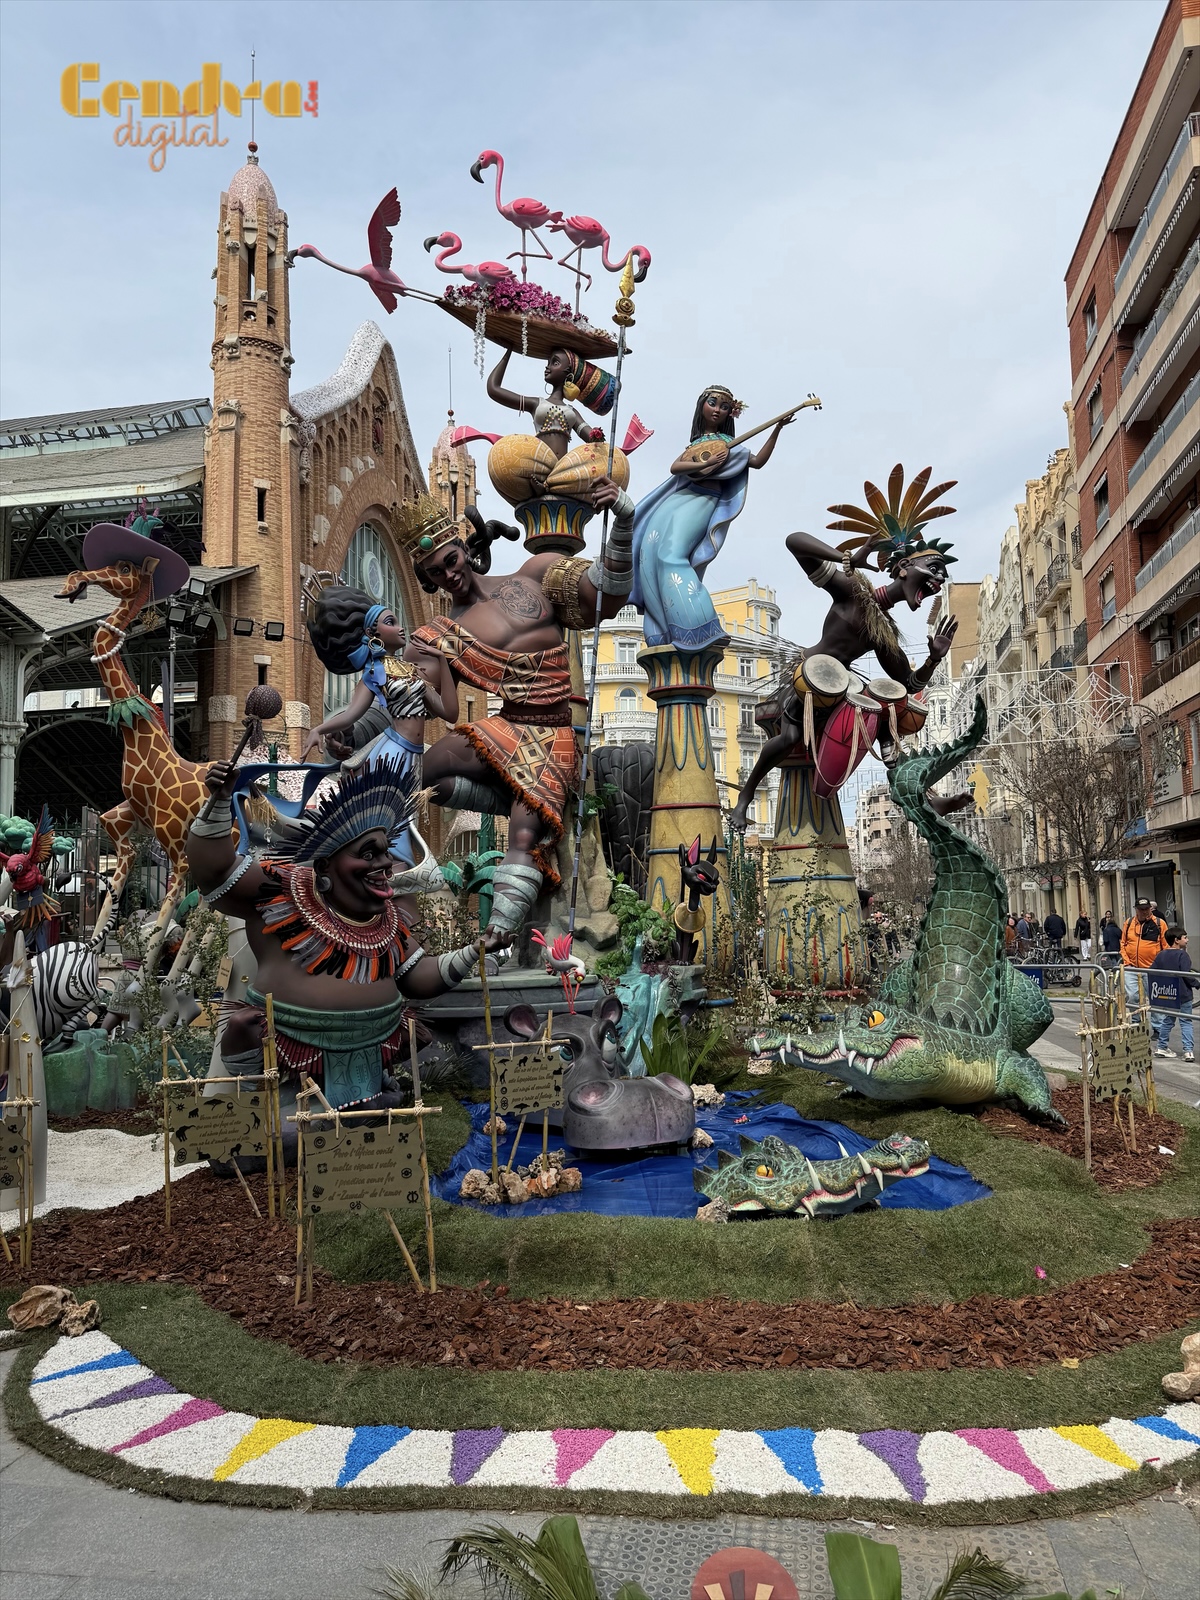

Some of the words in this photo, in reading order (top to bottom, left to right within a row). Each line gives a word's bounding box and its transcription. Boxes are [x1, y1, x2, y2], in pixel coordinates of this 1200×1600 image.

[1151, 981, 1177, 1000] Bertolín
[376, 1145, 395, 1155] conté
[332, 1162, 352, 1172] molta
